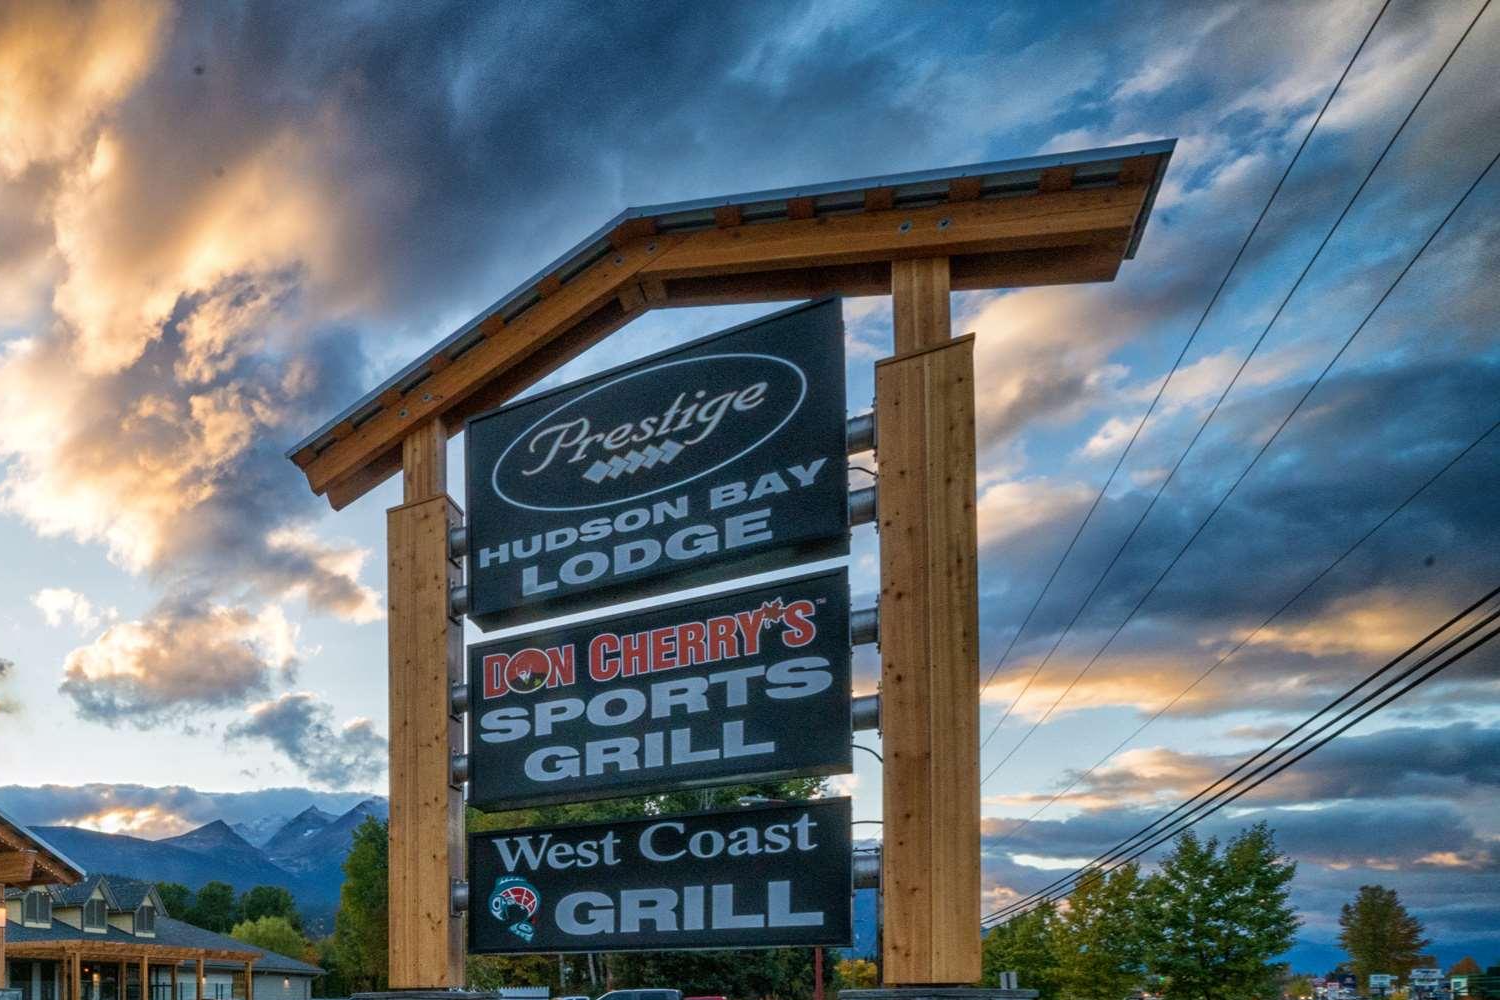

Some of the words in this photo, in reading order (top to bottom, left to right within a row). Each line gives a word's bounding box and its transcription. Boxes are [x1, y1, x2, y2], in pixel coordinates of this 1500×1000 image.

[522, 382, 768, 475] Prestige
[479, 496, 688, 568] HUDSON
[710, 457, 828, 510] BAY
[522, 508, 773, 597] LODGE
[483, 644, 576, 700] DON
[589, 600, 816, 682] CHERRY'S
[480, 656, 833, 744] SPORTS
[524, 720, 775, 782] GRILL
[492, 831, 621, 872] West
[638, 813, 818, 862] Coast
[555, 880, 825, 936] GRILL
